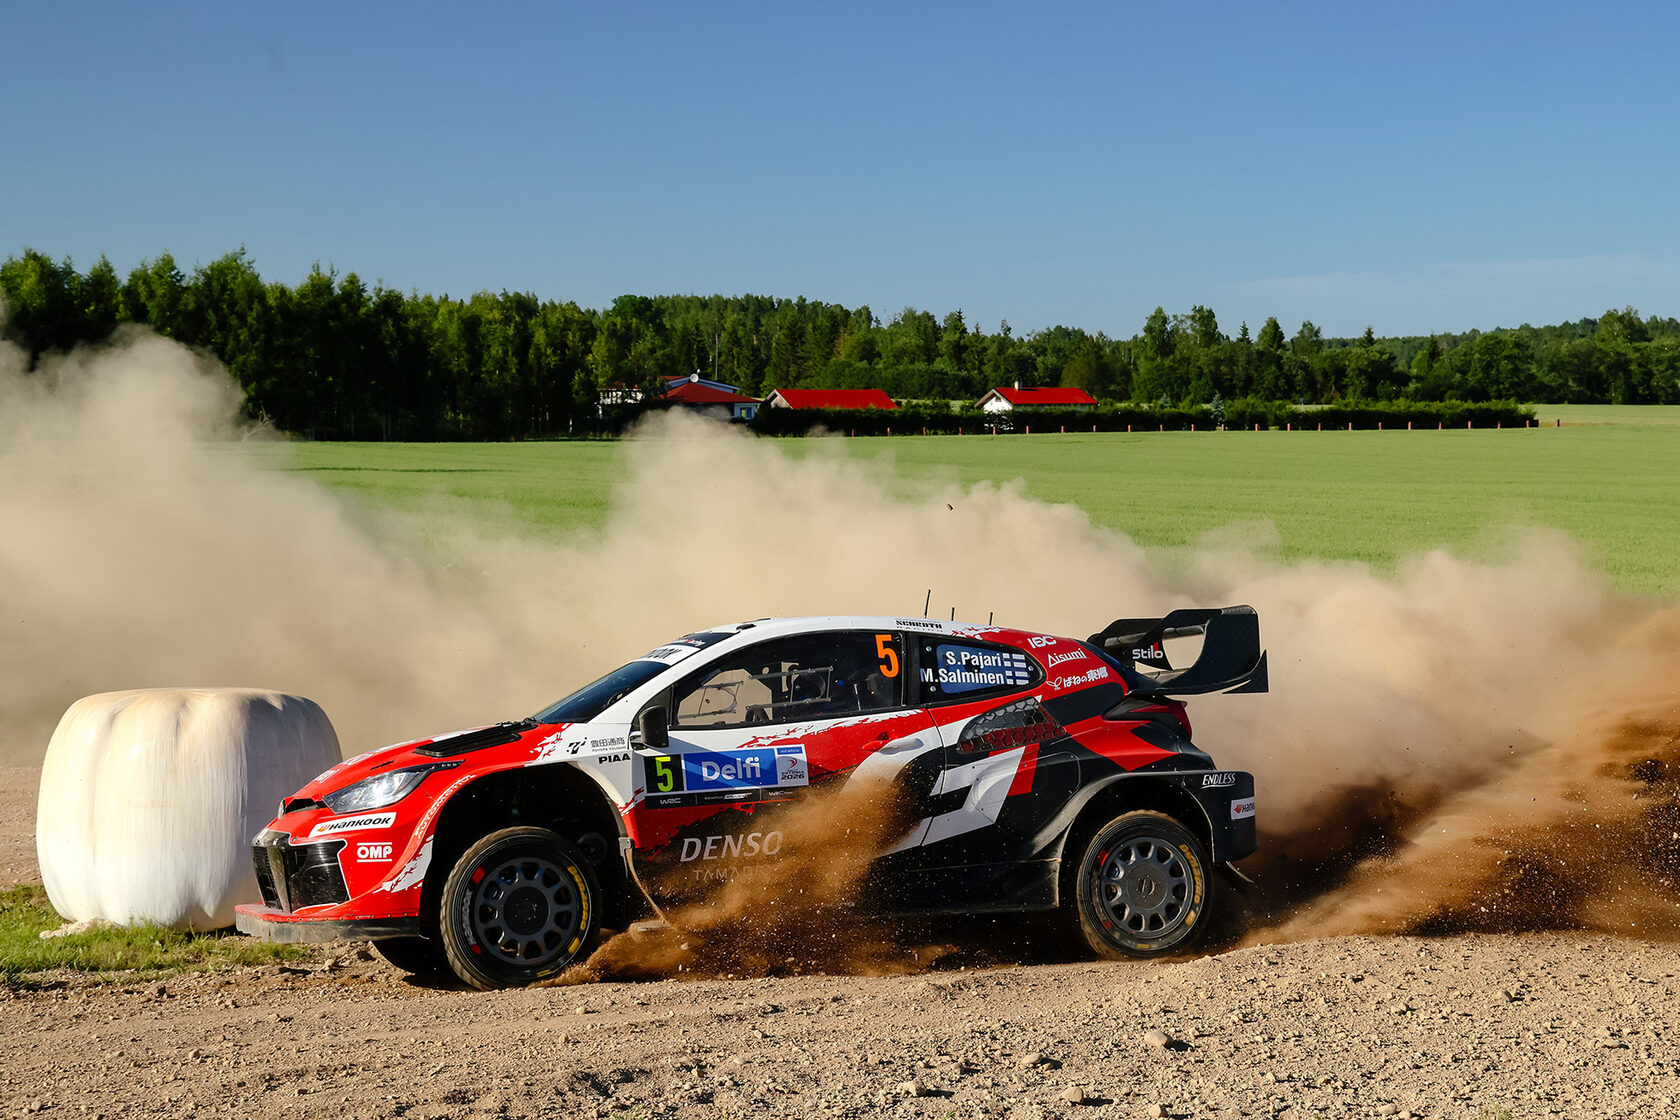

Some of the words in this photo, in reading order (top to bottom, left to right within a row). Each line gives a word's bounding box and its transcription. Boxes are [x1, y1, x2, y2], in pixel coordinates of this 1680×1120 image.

[896, 620, 943, 629] SCHROTH
[875, 634, 899, 678] 5
[946, 651, 1002, 669] S.Pajari
[1048, 648, 1087, 668] Aisumi
[1132, 644, 1163, 660] Stilo
[920, 668, 1005, 685] M.Salminen
[598, 753, 631, 764] PIAA
[655, 756, 674, 792] 5
[701, 757, 760, 781] Delfi
[1201, 773, 1236, 786] ENDLESS
[357, 845, 393, 859] OMP
[680, 831, 783, 862] DENSO
